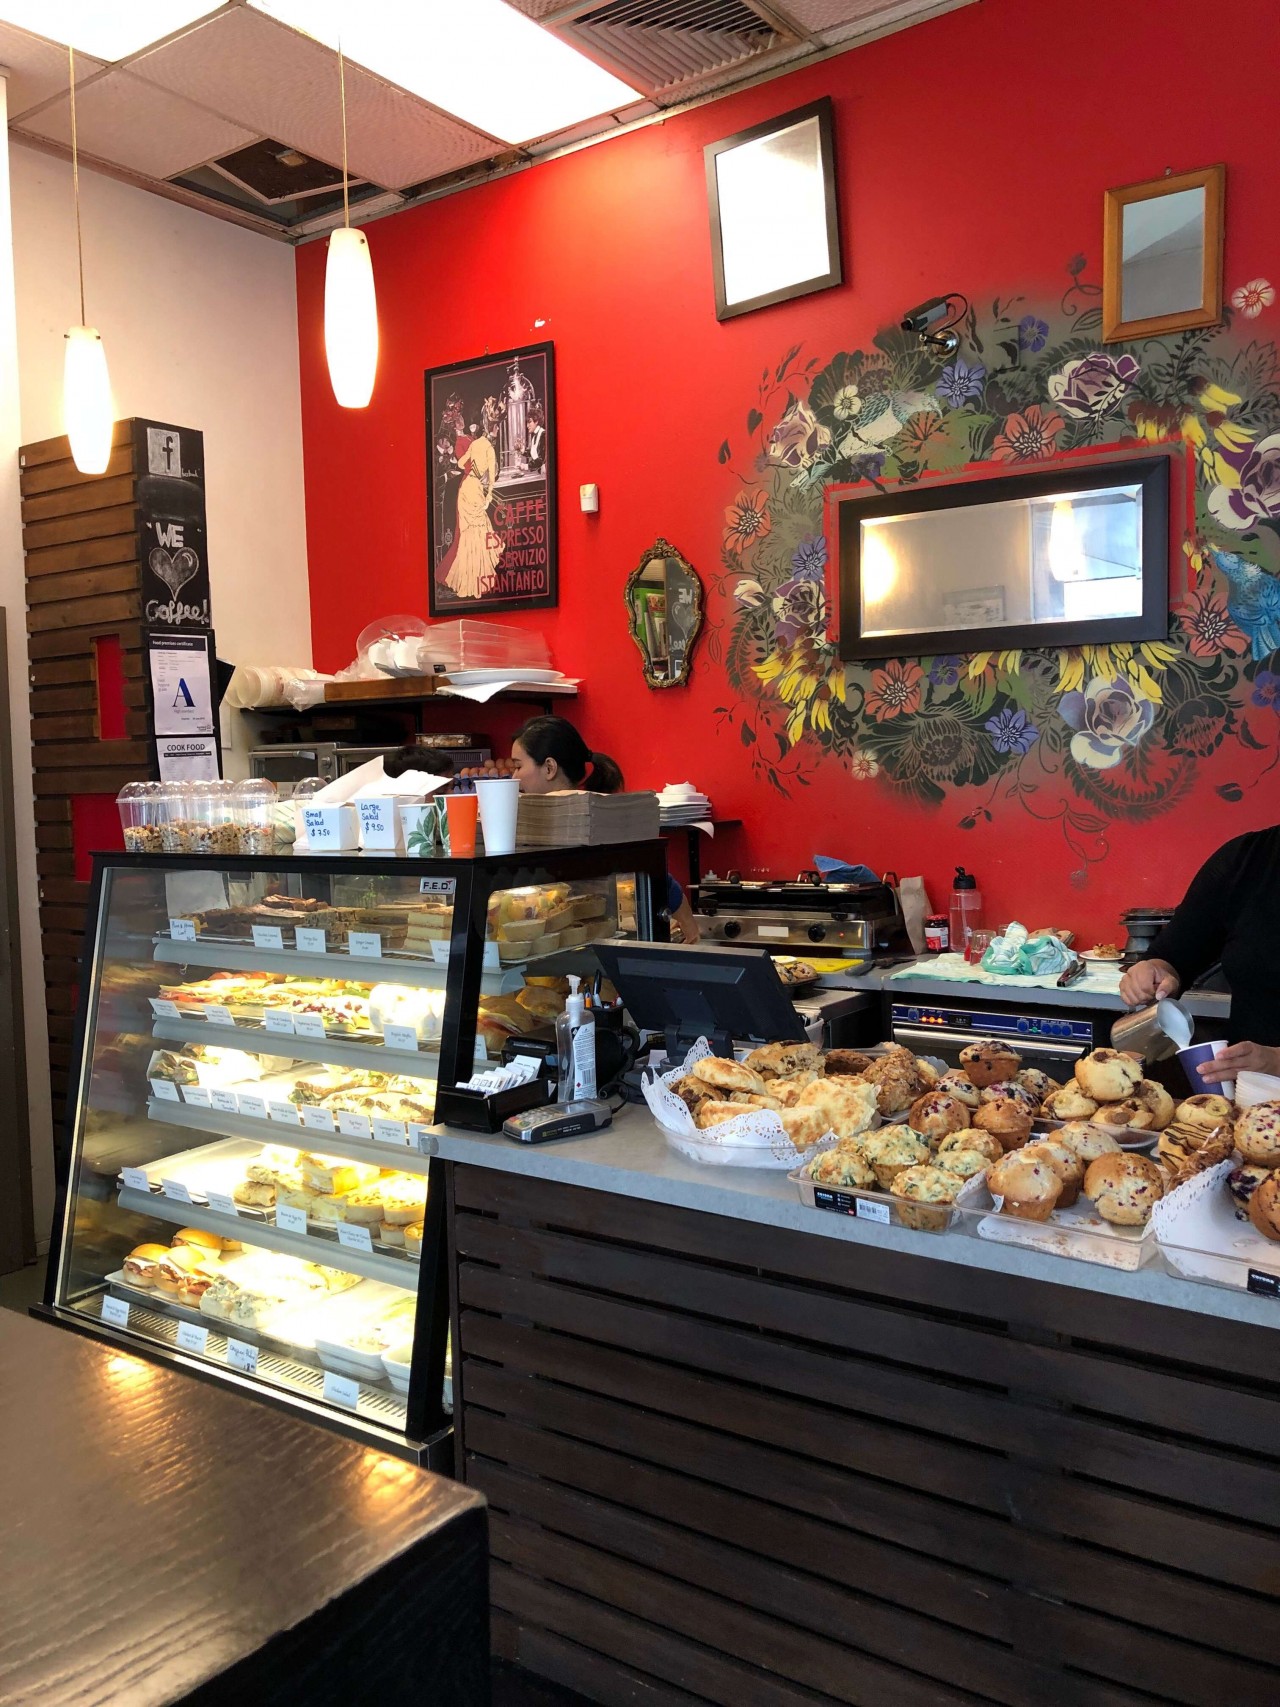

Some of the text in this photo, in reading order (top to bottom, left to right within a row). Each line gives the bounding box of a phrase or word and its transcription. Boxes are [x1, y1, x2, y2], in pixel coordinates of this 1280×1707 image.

[155, 522, 185, 549] WE
[485, 525, 545, 550] ESPRESSO
[498, 547, 546, 569] SERVIZIO
[476, 570, 544, 595] ISTANTANEO
[145, 599, 210, 625] Coffee!
[172, 677, 196, 708] A
[166, 743, 206, 752] COOK FOOD
[305, 811, 322, 819] Small
[360, 803, 381, 815] Large
[361, 812, 379, 821] Salad
[306, 819, 324, 827] Salad
